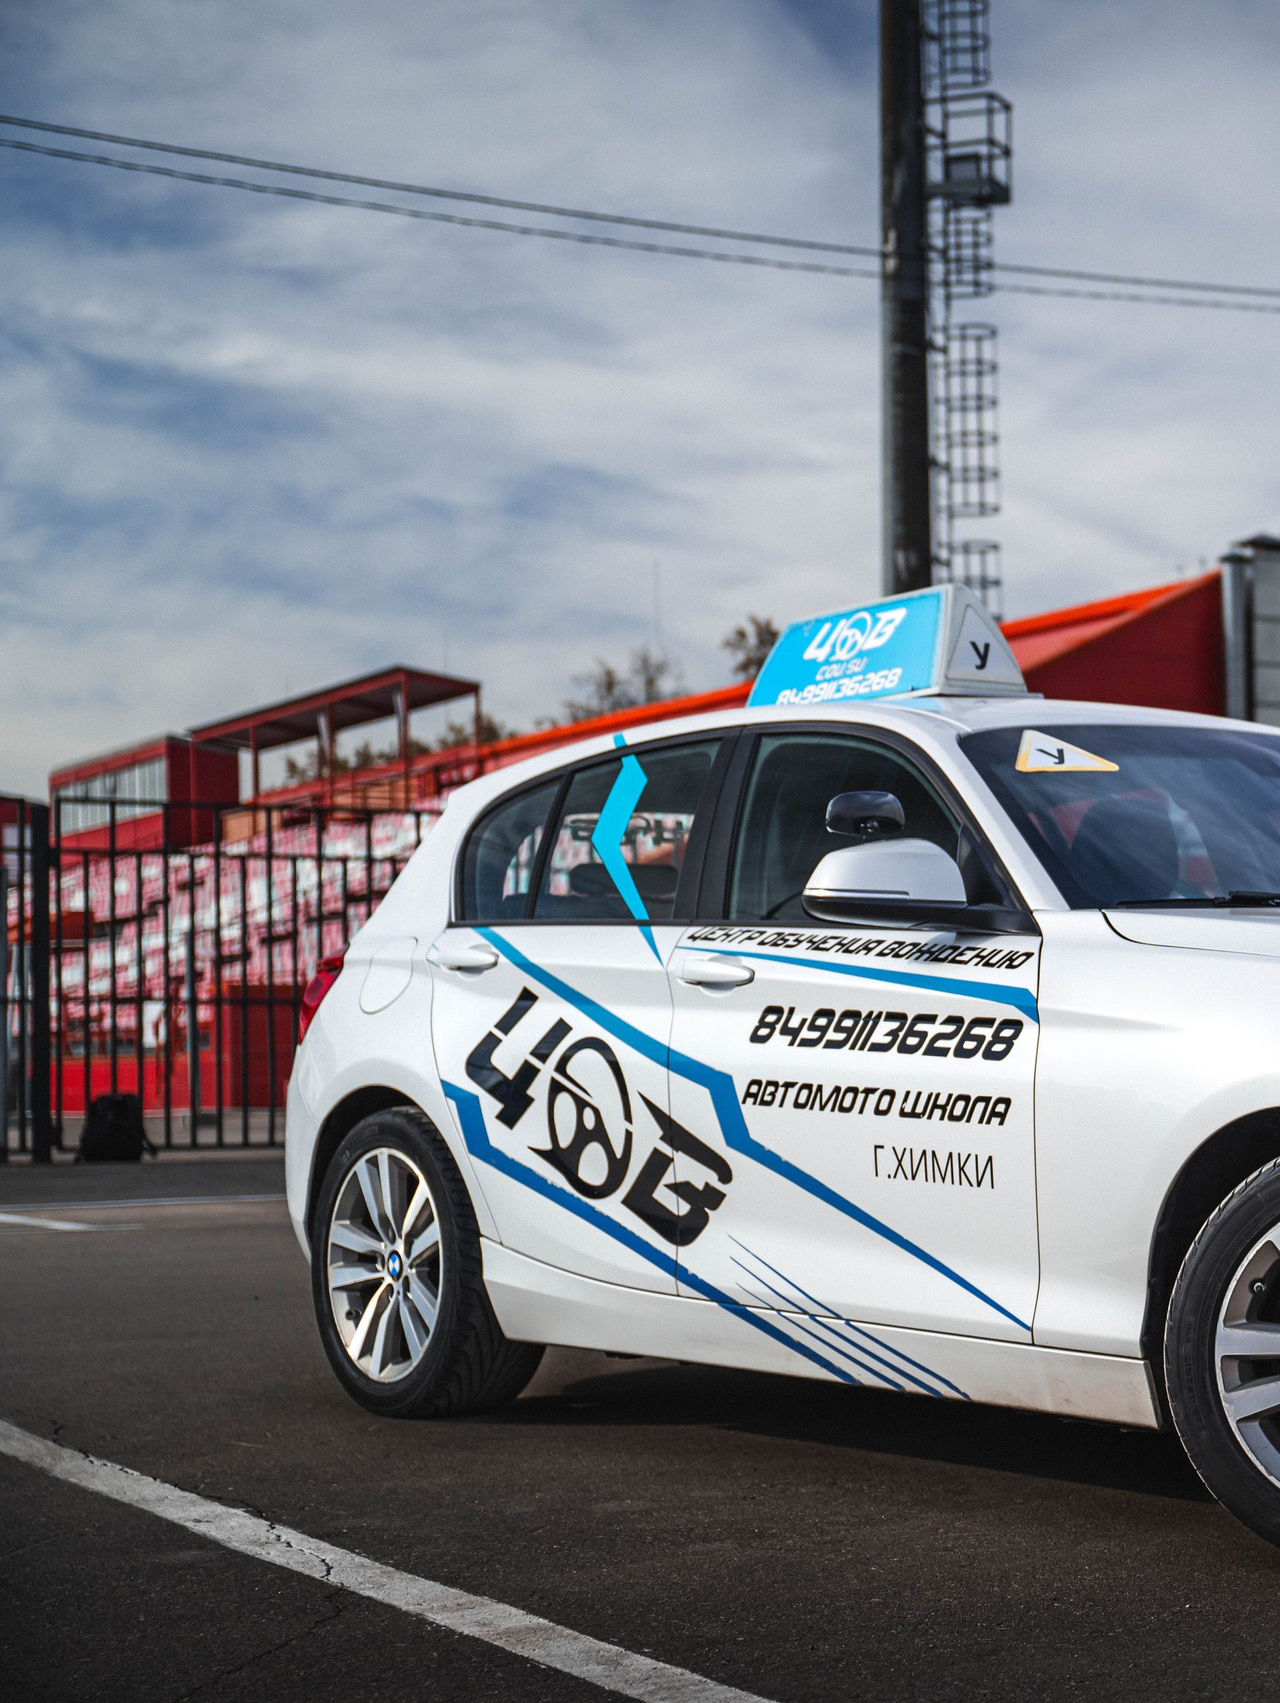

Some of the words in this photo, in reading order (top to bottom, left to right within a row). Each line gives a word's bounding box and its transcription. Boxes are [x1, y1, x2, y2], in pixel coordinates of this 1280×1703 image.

[970, 640, 990, 670] У
[1035, 747, 1065, 765] У
[687, 925, 767, 944] ЦЕНТР
[757, 931, 886, 956] ОБУЧЕНИЯ
[875, 941, 1035, 970] ВОЖДЕНИЮ
[749, 1005, 1024, 1061] 84991136268
[741, 1079, 897, 1117] АВТОМОТО
[898, 1090, 1013, 1126] ШКОЛА
[873, 1144, 995, 1190] Г.ХИМКИ
